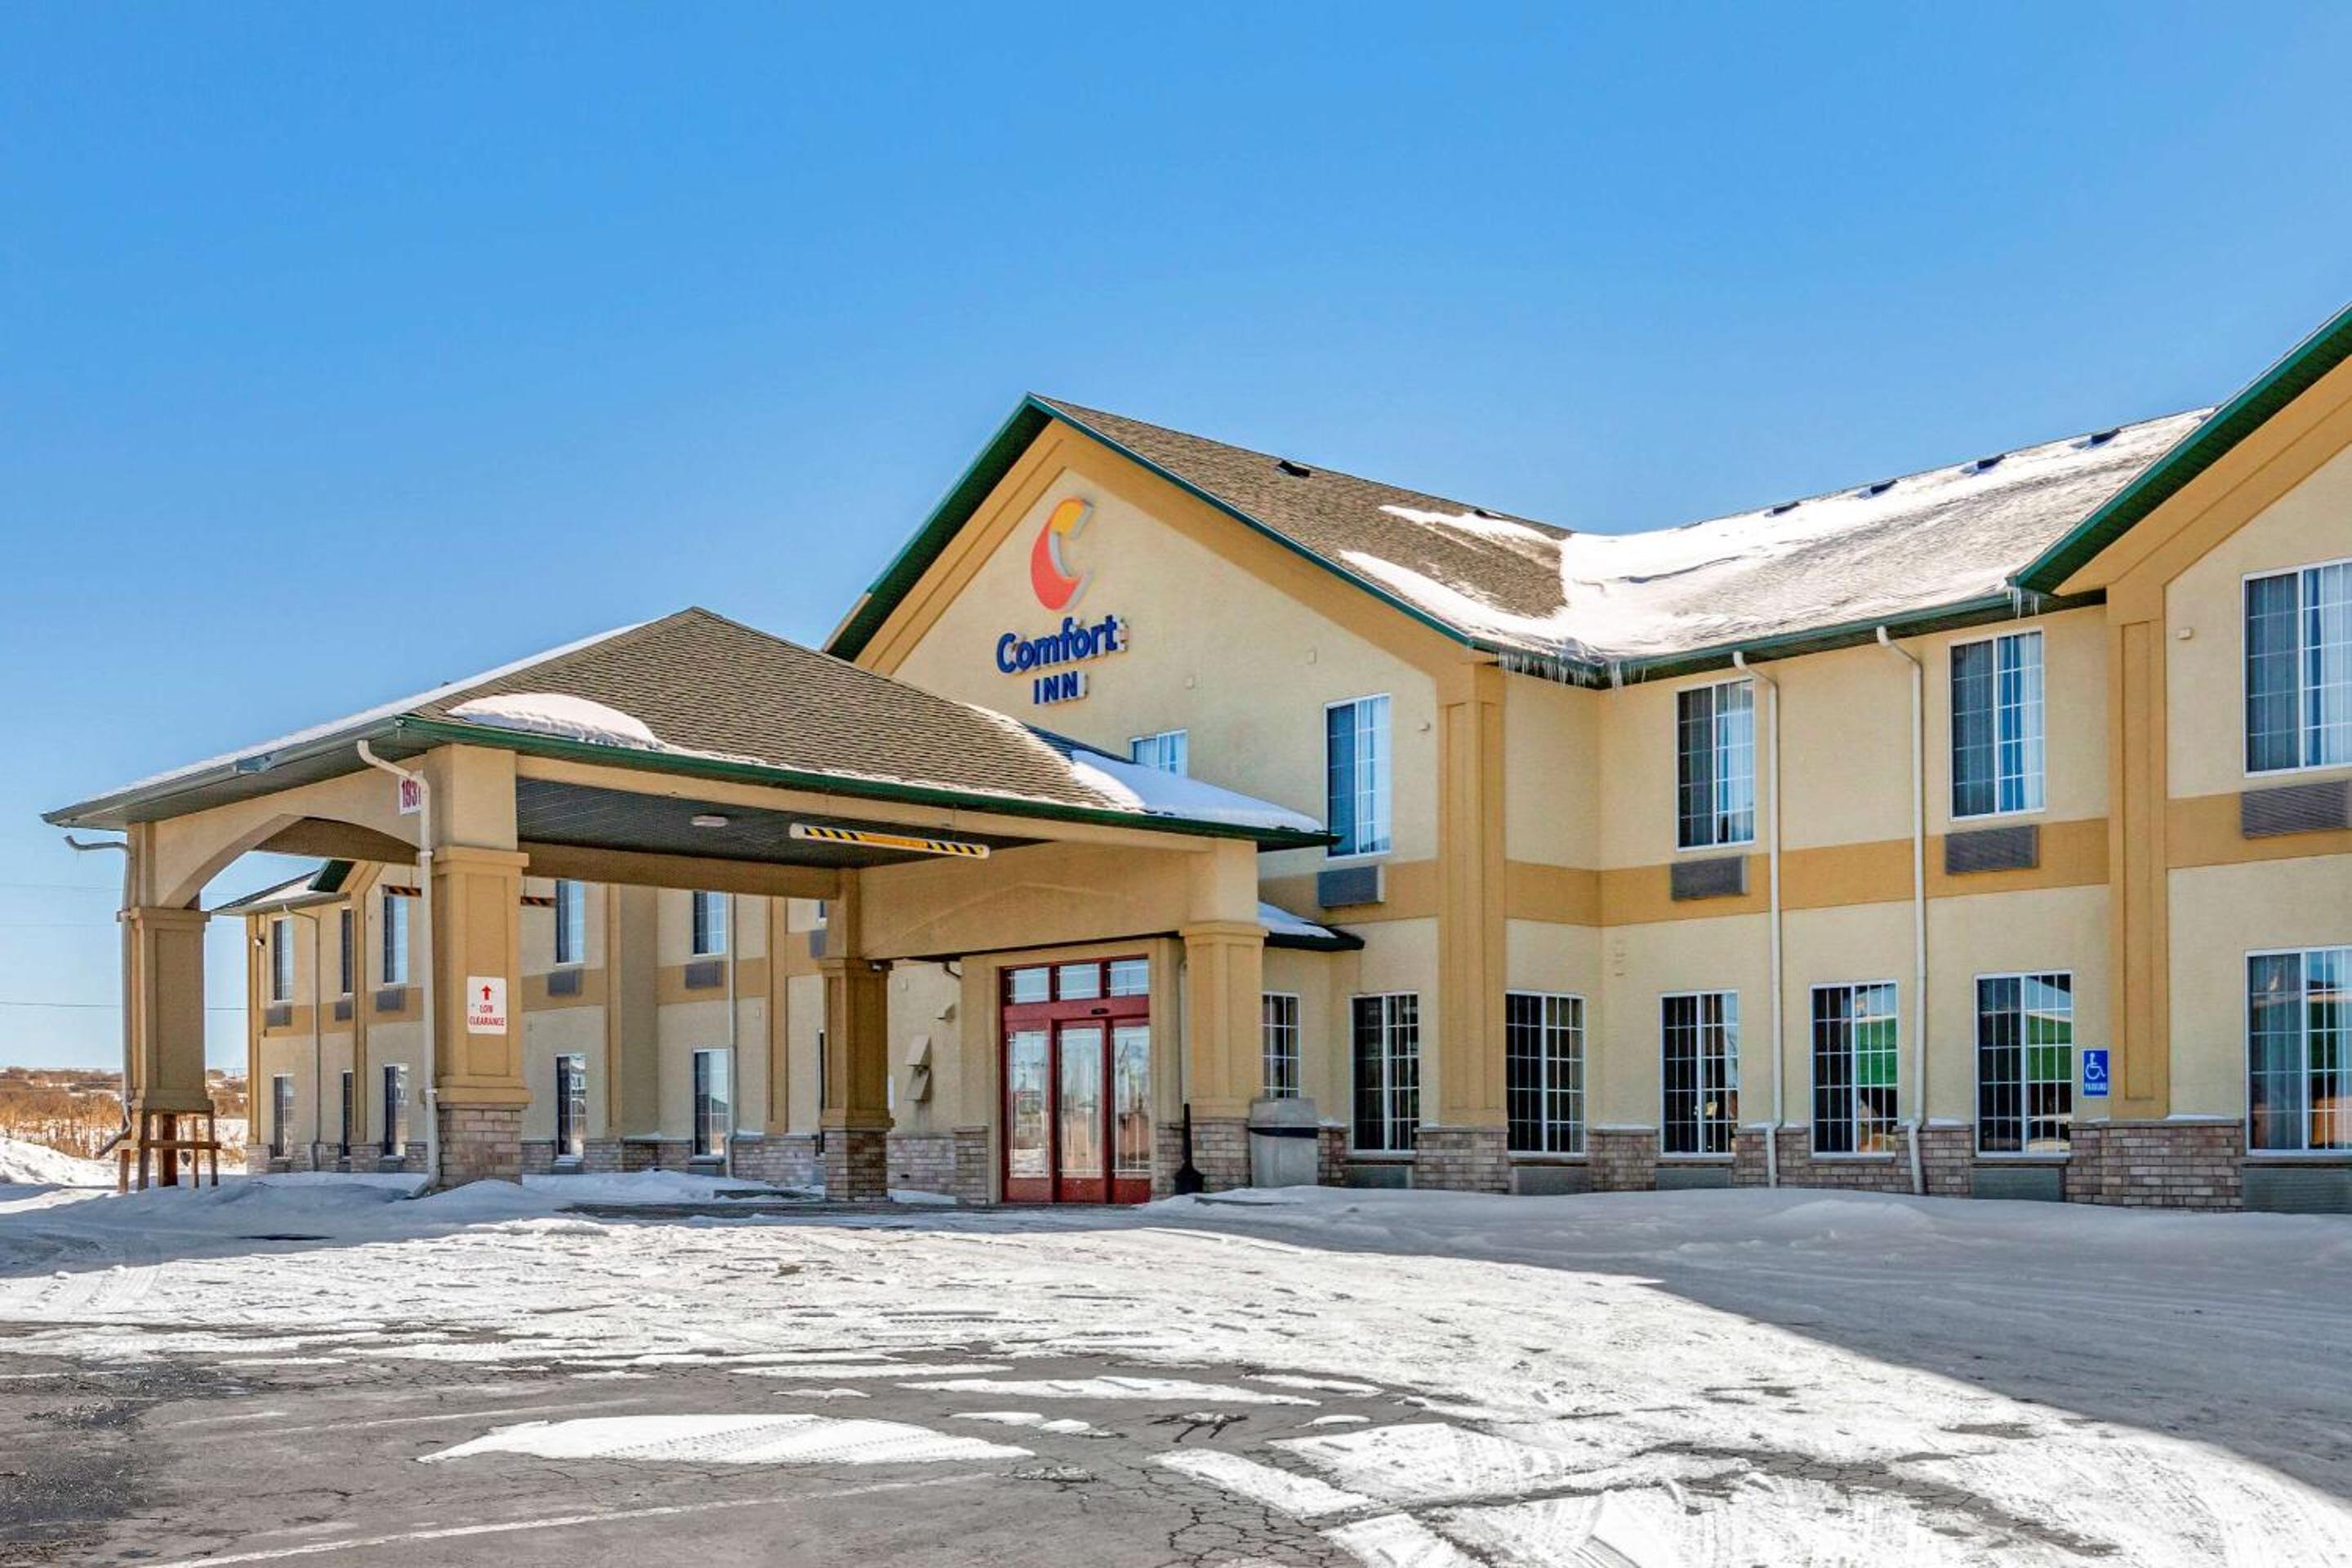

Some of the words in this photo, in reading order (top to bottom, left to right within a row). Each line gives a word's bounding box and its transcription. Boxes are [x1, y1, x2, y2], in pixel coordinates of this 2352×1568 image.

[996, 614, 1119, 674] Comfort
[1033, 670, 1079, 705] INN
[469, 1016, 506, 1027] CLEARANCE
